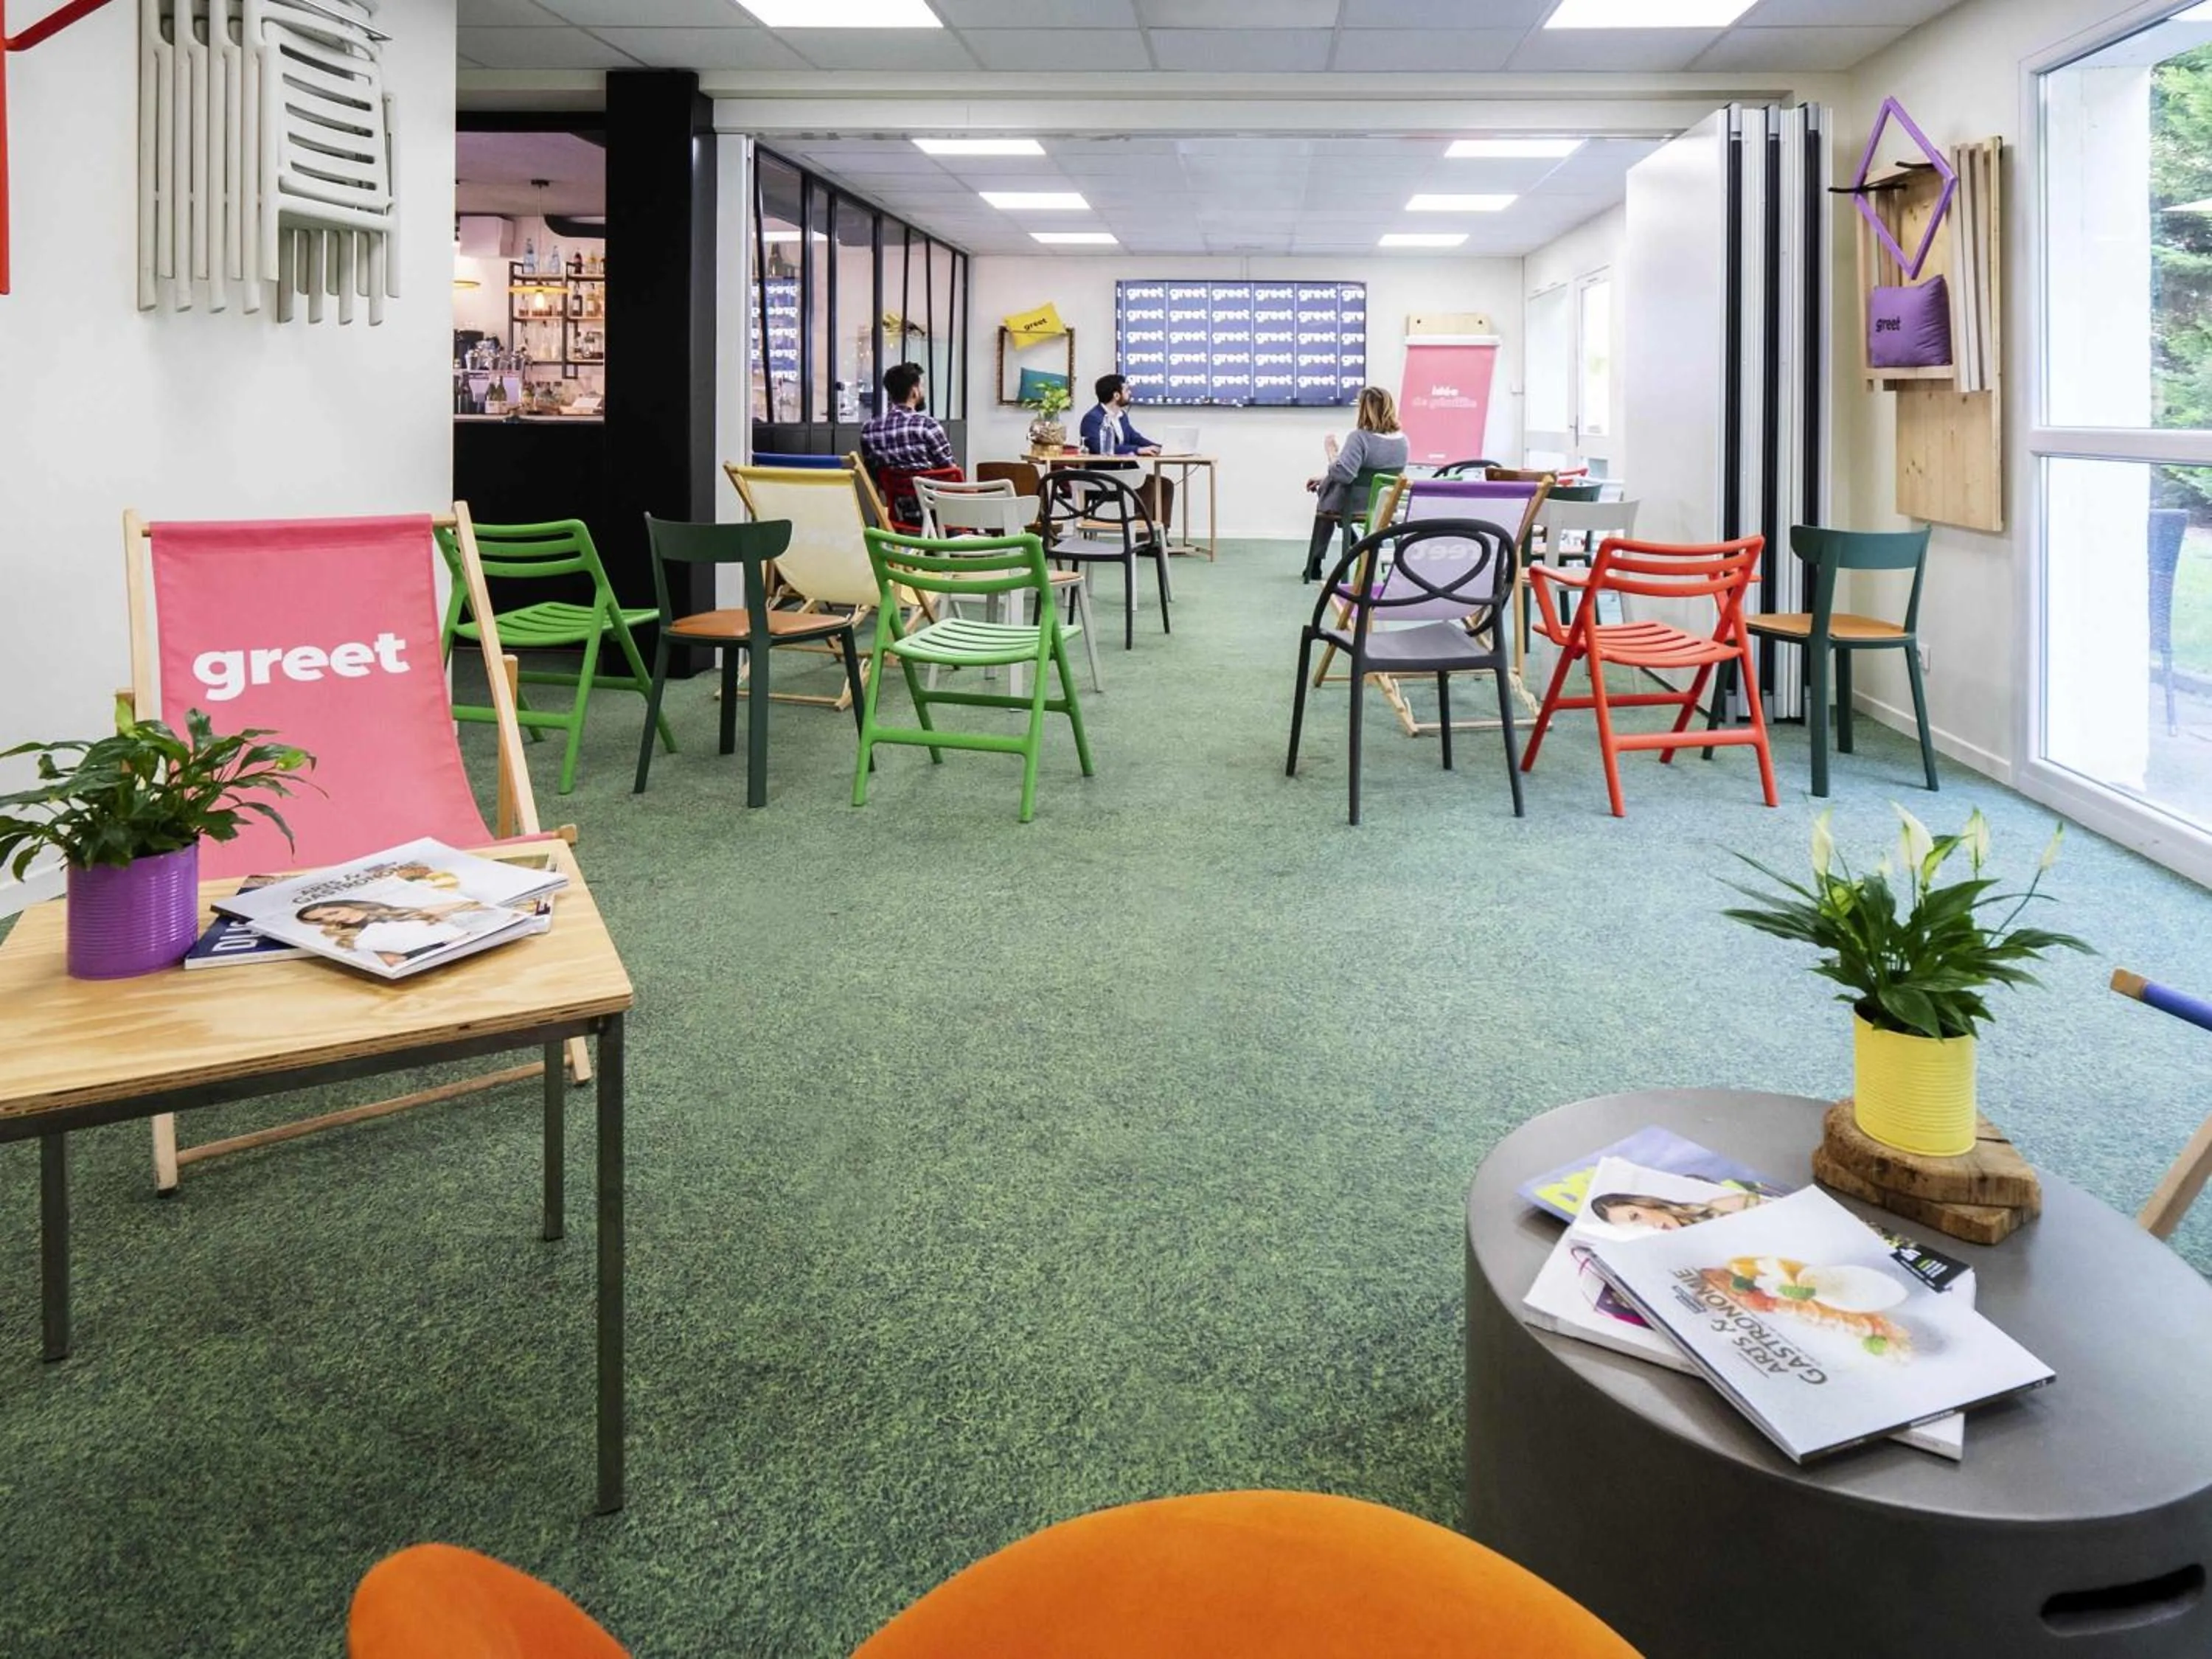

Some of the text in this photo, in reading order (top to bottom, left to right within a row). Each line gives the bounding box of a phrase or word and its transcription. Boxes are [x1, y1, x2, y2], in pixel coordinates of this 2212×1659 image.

[1127, 288, 1164, 300] greet
[1169, 288, 1207, 300] greet
[1211, 288, 1250, 301] greet
[1255, 288, 1293, 301] greet
[1298, 288, 1336, 302] greet
[1341, 290, 1365, 302] gre
[1127, 309, 1164, 321] greet
[1169, 309, 1207, 322] greet
[1211, 310, 1250, 322] greet
[1255, 310, 1293, 323] greet
[1298, 310, 1336, 323] greet
[1341, 311, 1365, 323] gre
[1023, 318, 1048, 331] greet
[1875, 316, 1900, 333] greet
[1127, 330, 1164, 343] greet
[1169, 330, 1207, 344] greet
[1211, 331, 1250, 344] greet
[1255, 332, 1293, 344] greet
[1298, 332, 1336, 345] greet
[1341, 333, 1365, 345] gre
[1127, 352, 1164, 364] greet
[1169, 352, 1207, 365] greet
[1211, 352, 1250, 366] greet
[1255, 353, 1293, 366] greet
[1298, 353, 1336, 366] greet
[1341, 355, 1365, 366] gre
[1127, 374, 1365, 388] greet greet greet greet greet gre
[192, 633, 411, 700] greet
[1673, 1267, 1829, 1385] GASTRONOMIE
[1710, 1318, 1736, 1333] &
[1732, 1335, 1790, 1374] ARTS
